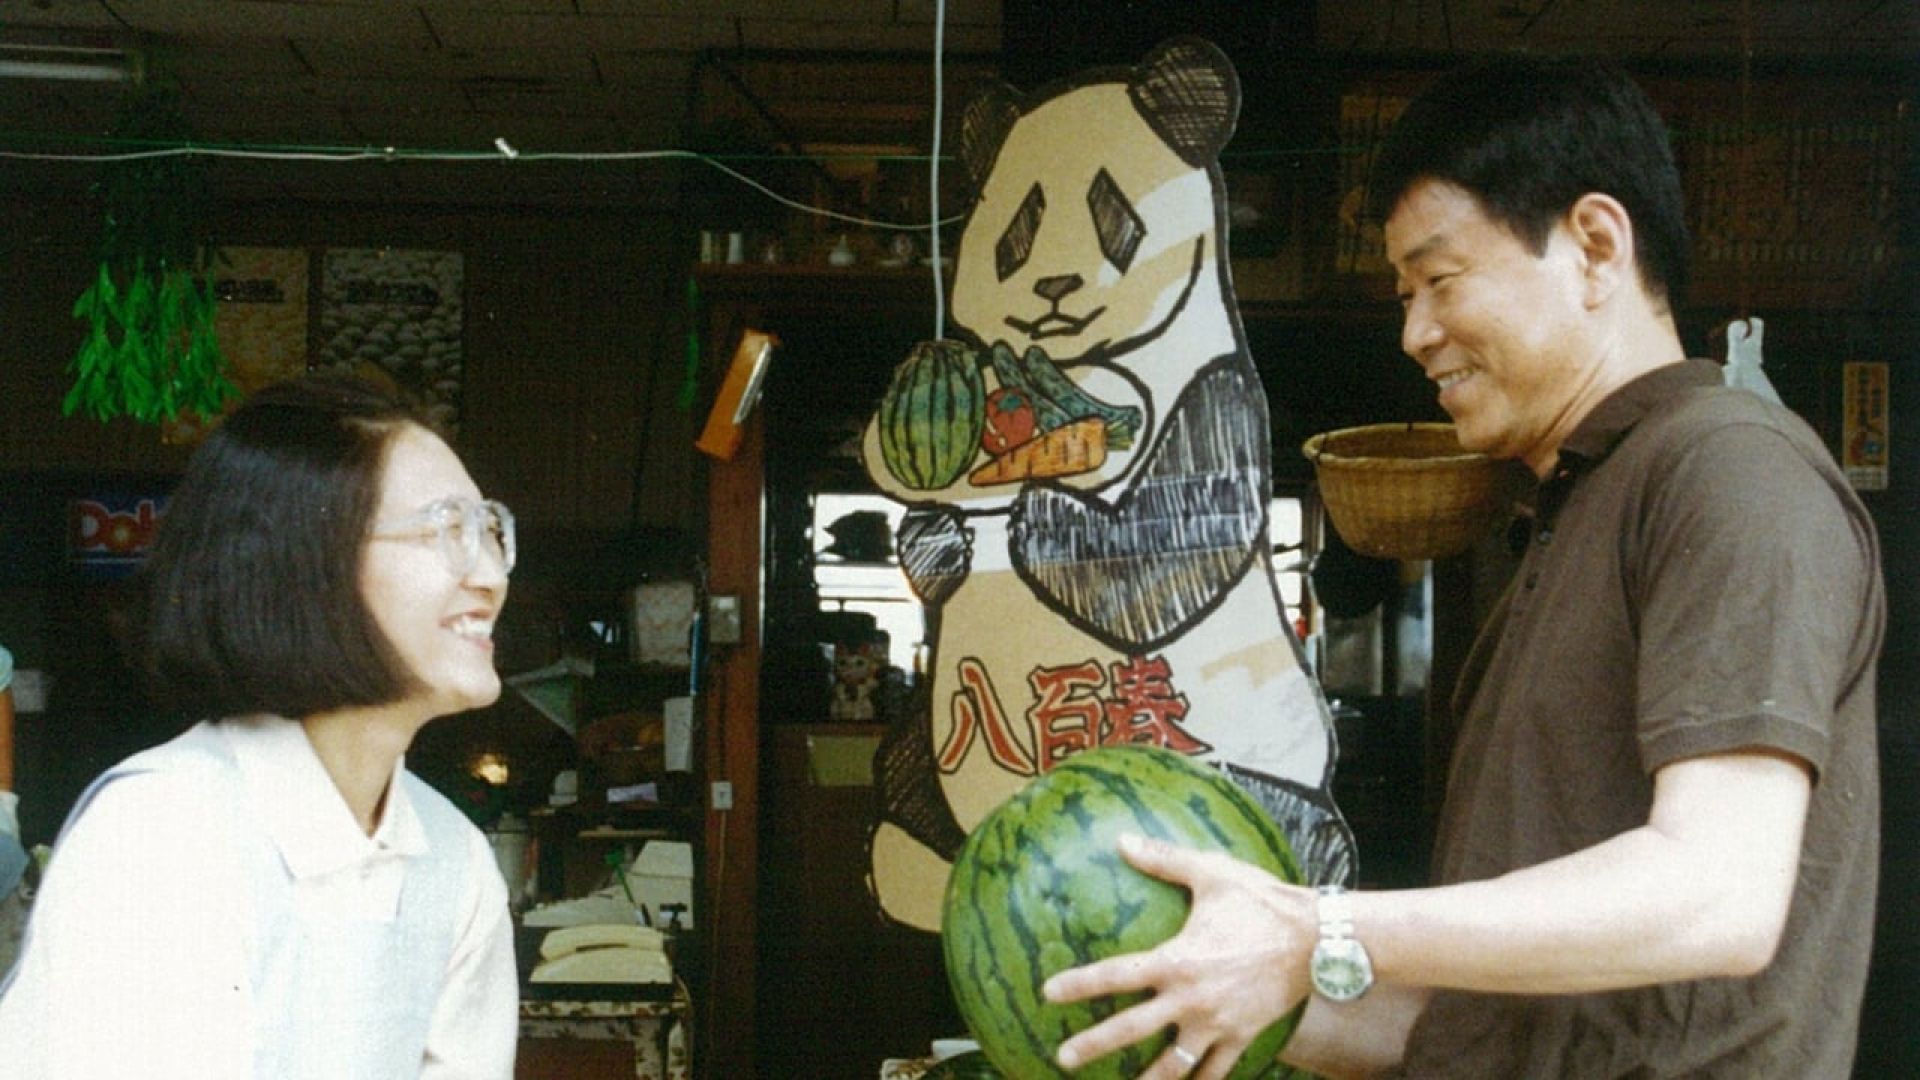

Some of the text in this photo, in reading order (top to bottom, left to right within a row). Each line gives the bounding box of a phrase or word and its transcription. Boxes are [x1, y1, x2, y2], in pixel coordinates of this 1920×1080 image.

[76, 500, 160, 552] Dol
[938, 653, 1213, 776] 八百春
